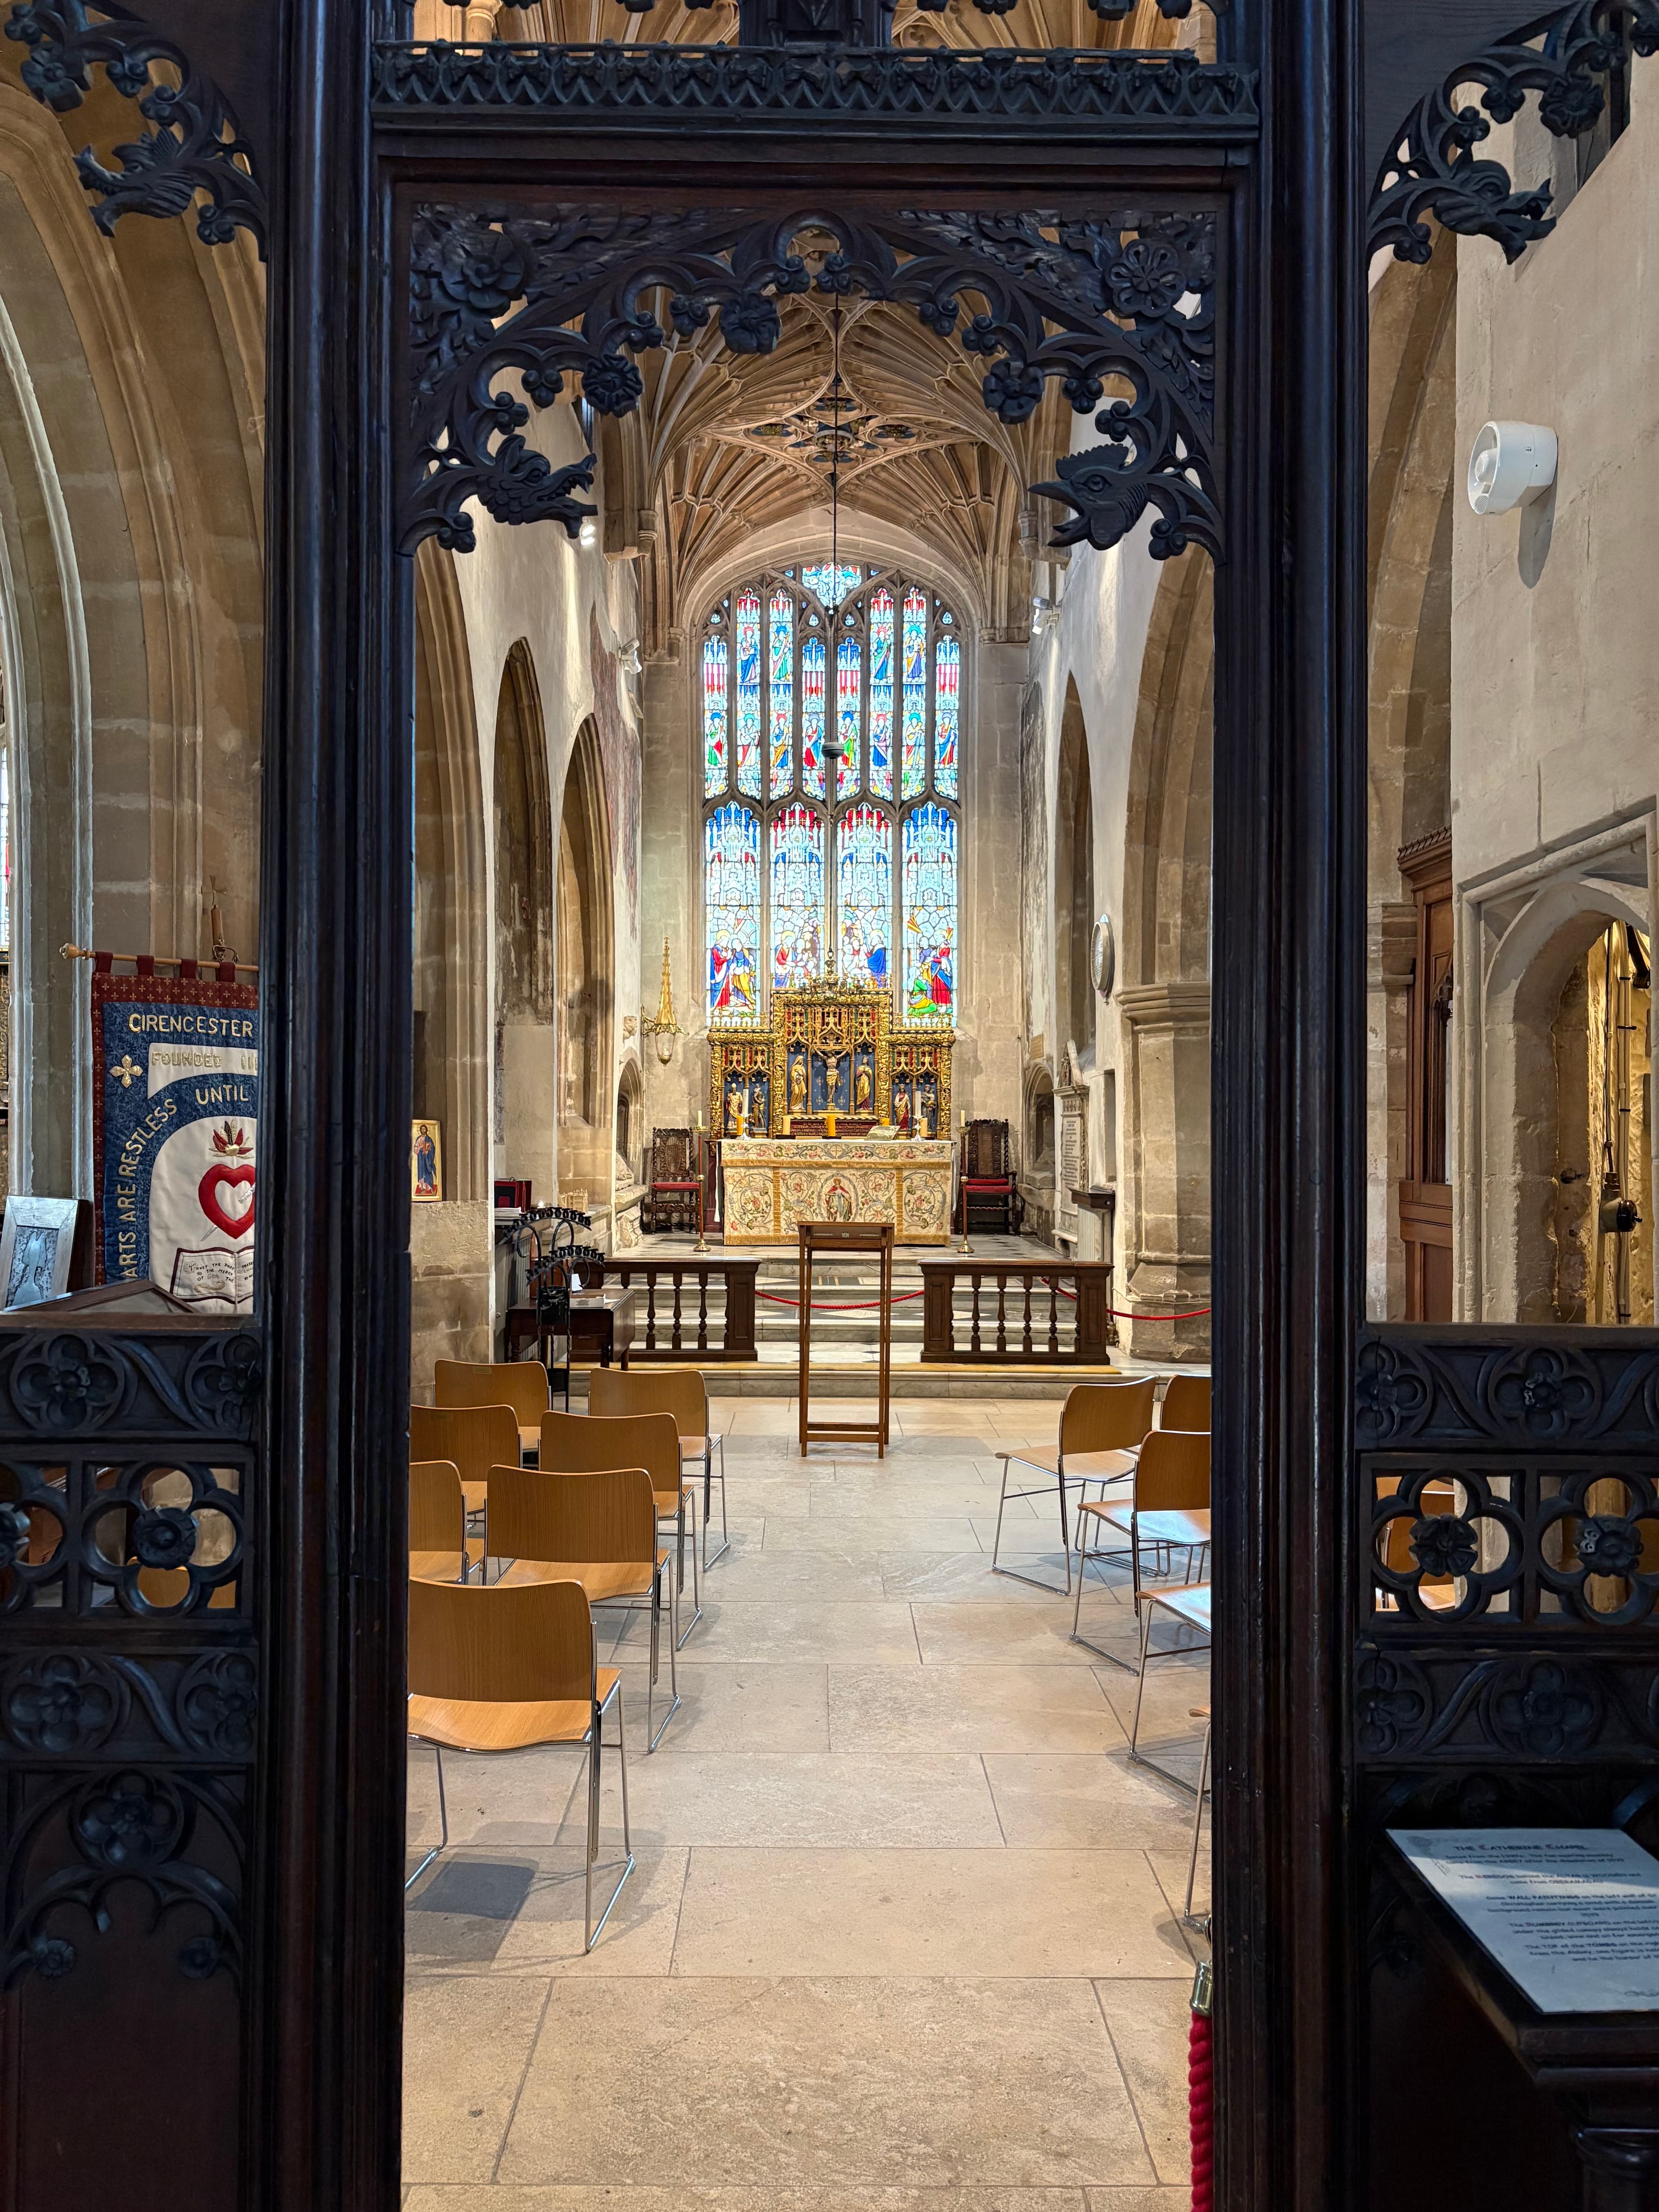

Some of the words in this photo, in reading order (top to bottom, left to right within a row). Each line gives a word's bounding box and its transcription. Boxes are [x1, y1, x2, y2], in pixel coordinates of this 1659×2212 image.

[128, 1013, 253, 1037] CIRENCESTER
[152, 1051, 222, 1068] FOUNDED
[195, 1084, 249, 1105] UNTIL
[118, 1098, 177, 1177] RESTLESS
[117, 1184, 136, 1221] ARE
